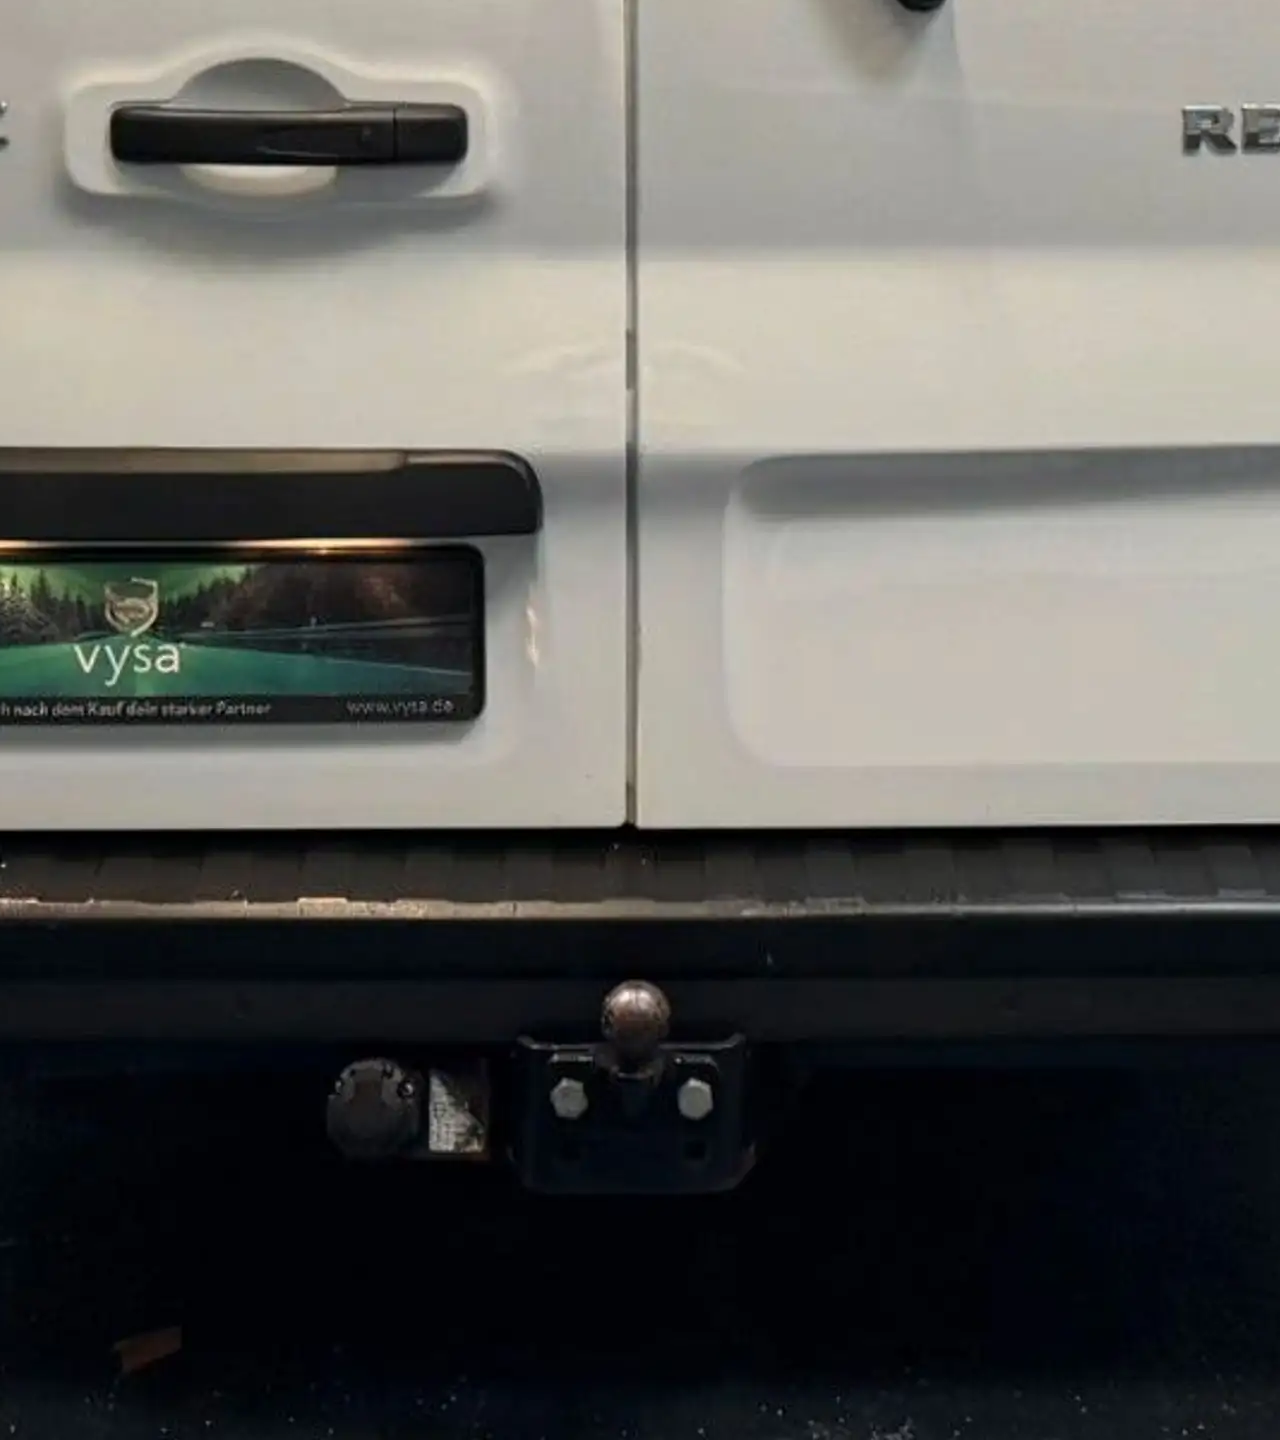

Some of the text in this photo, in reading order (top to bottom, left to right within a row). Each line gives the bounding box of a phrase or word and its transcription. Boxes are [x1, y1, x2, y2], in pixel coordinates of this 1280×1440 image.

[73, 644, 180, 687] vysa
[13, 701, 48, 717] nach
[51, 702, 84, 717] dem
[86, 700, 125, 717] Kauf
[215, 700, 271, 717] Partner
